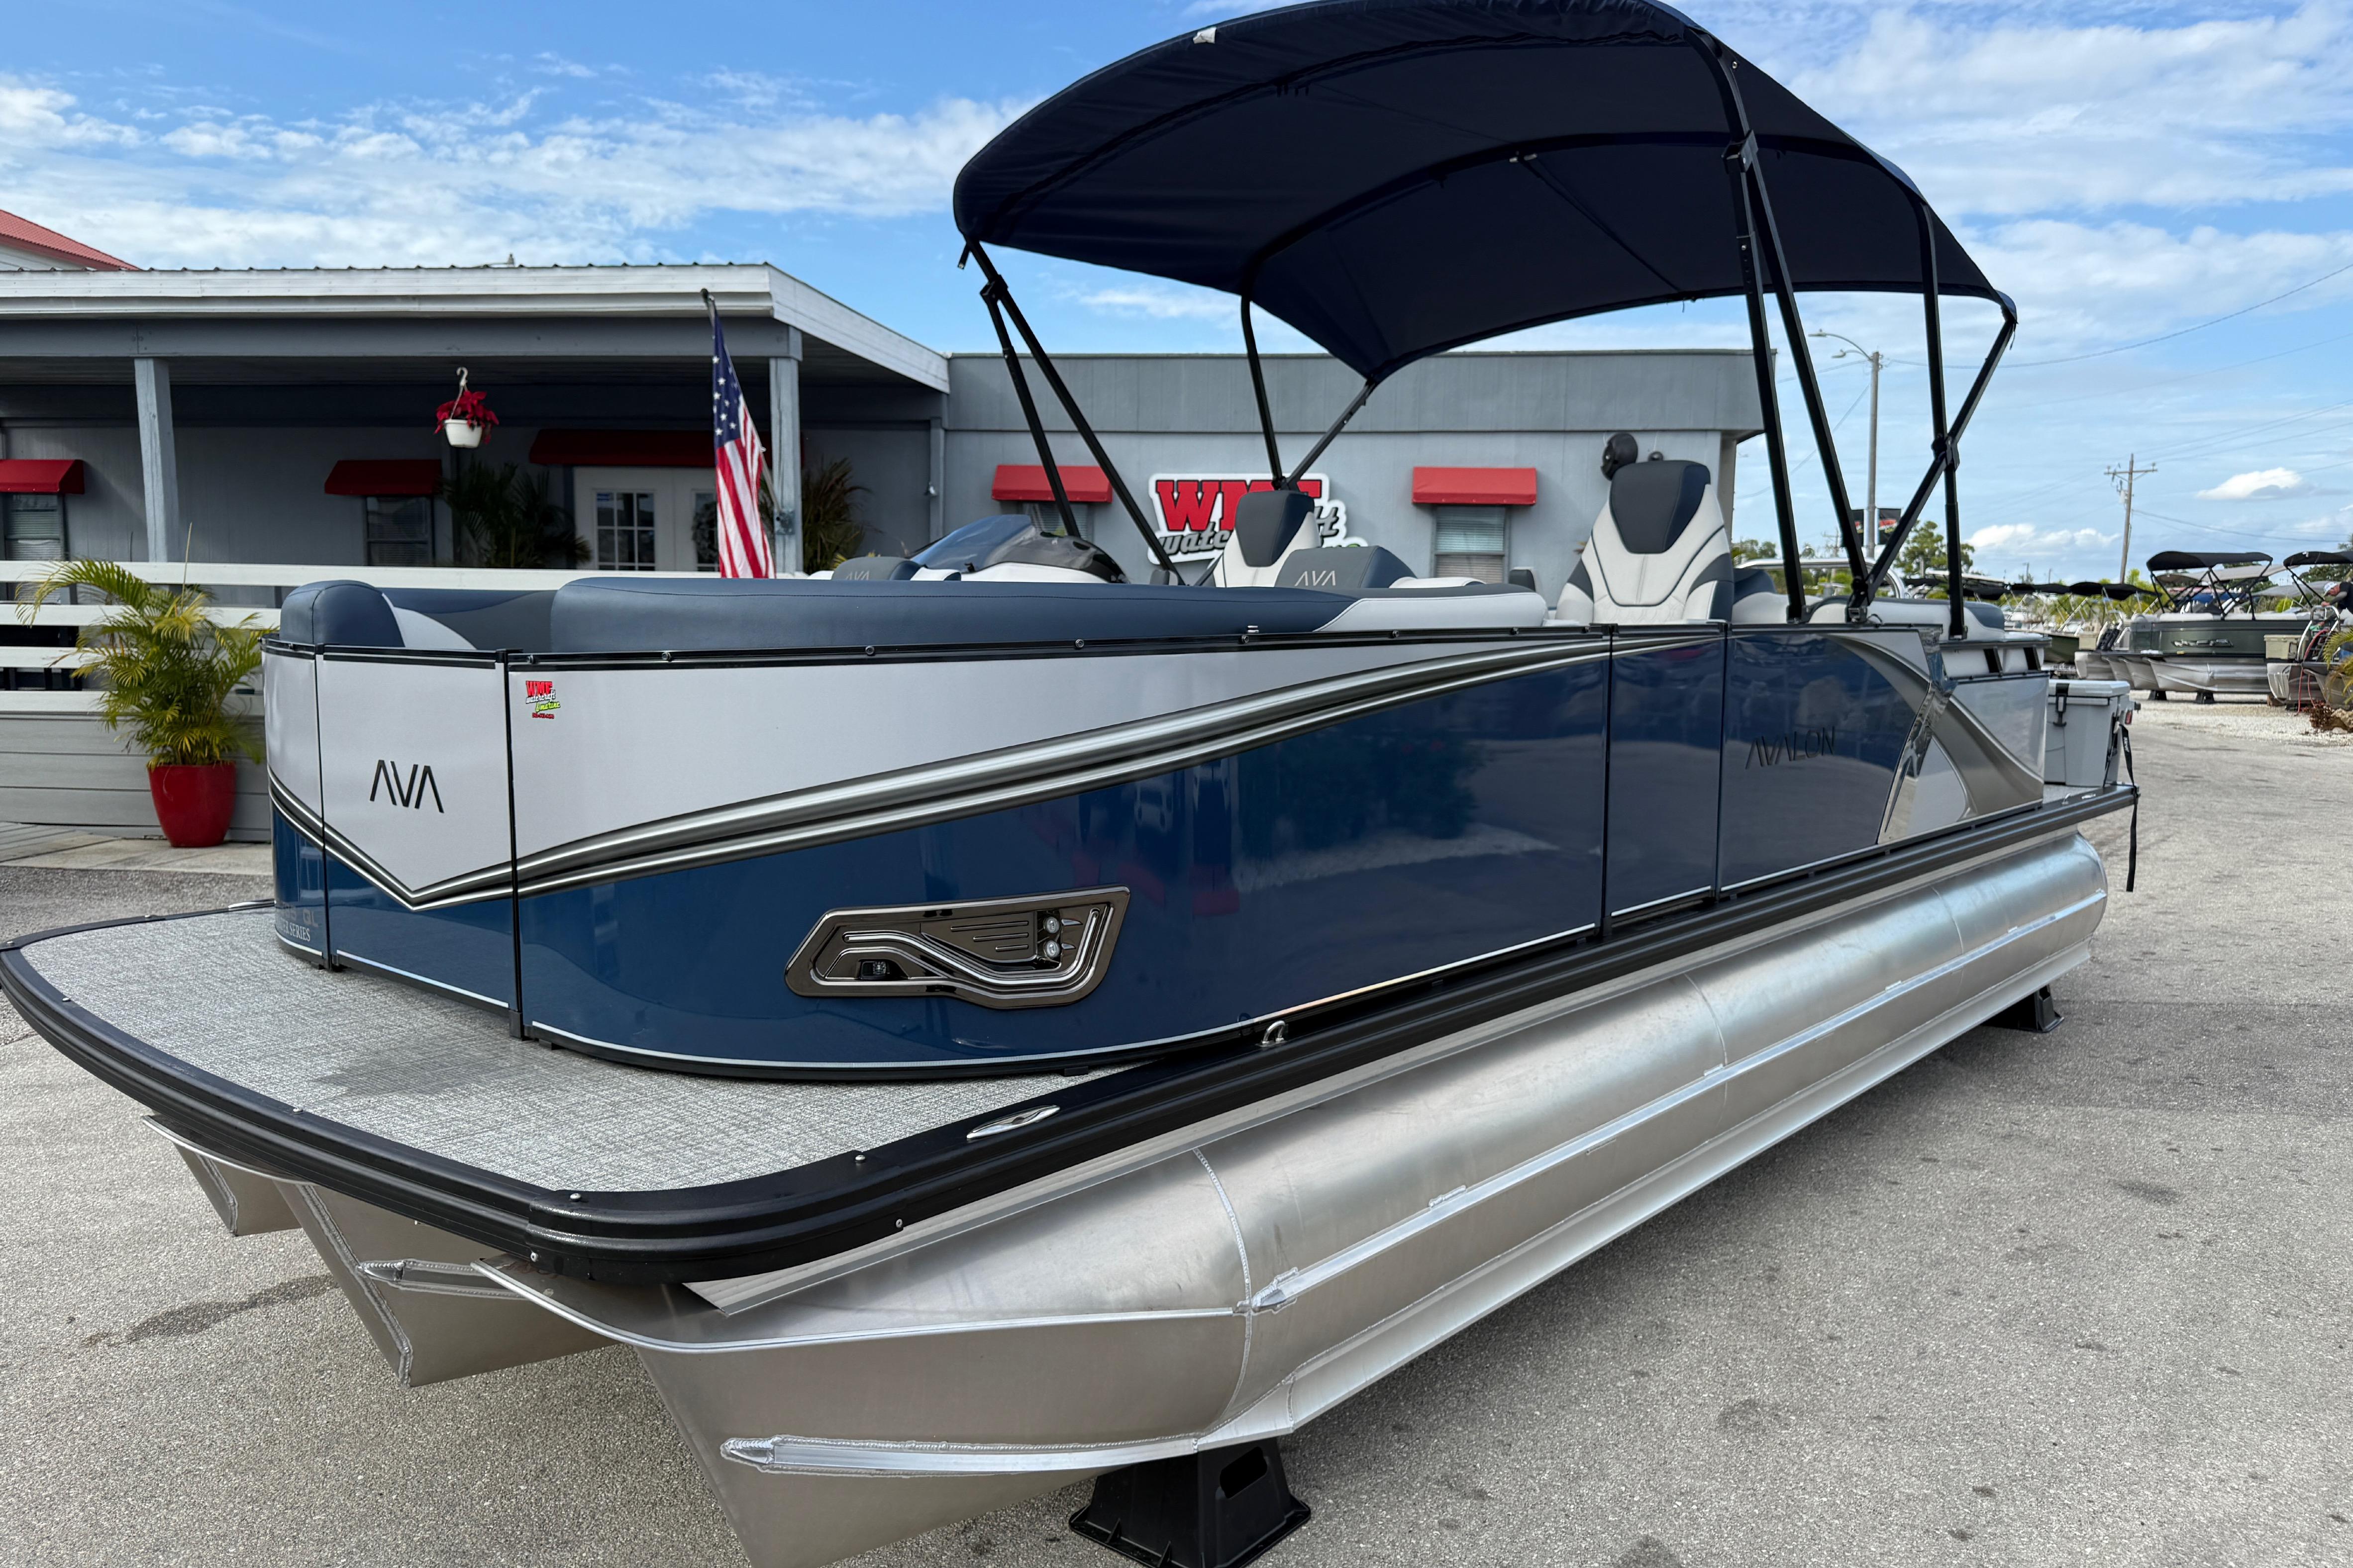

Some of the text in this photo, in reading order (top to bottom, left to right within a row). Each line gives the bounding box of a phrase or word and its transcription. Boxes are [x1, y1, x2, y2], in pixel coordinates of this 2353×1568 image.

[1156, 480, 1321, 531] WM
[1294, 571, 1336, 586] AVA
[526, 681, 552, 697] WMF
[1745, 726, 1835, 770] AVALON
[370, 759, 444, 813] AVA
[289, 922, 310, 942] SERIES
